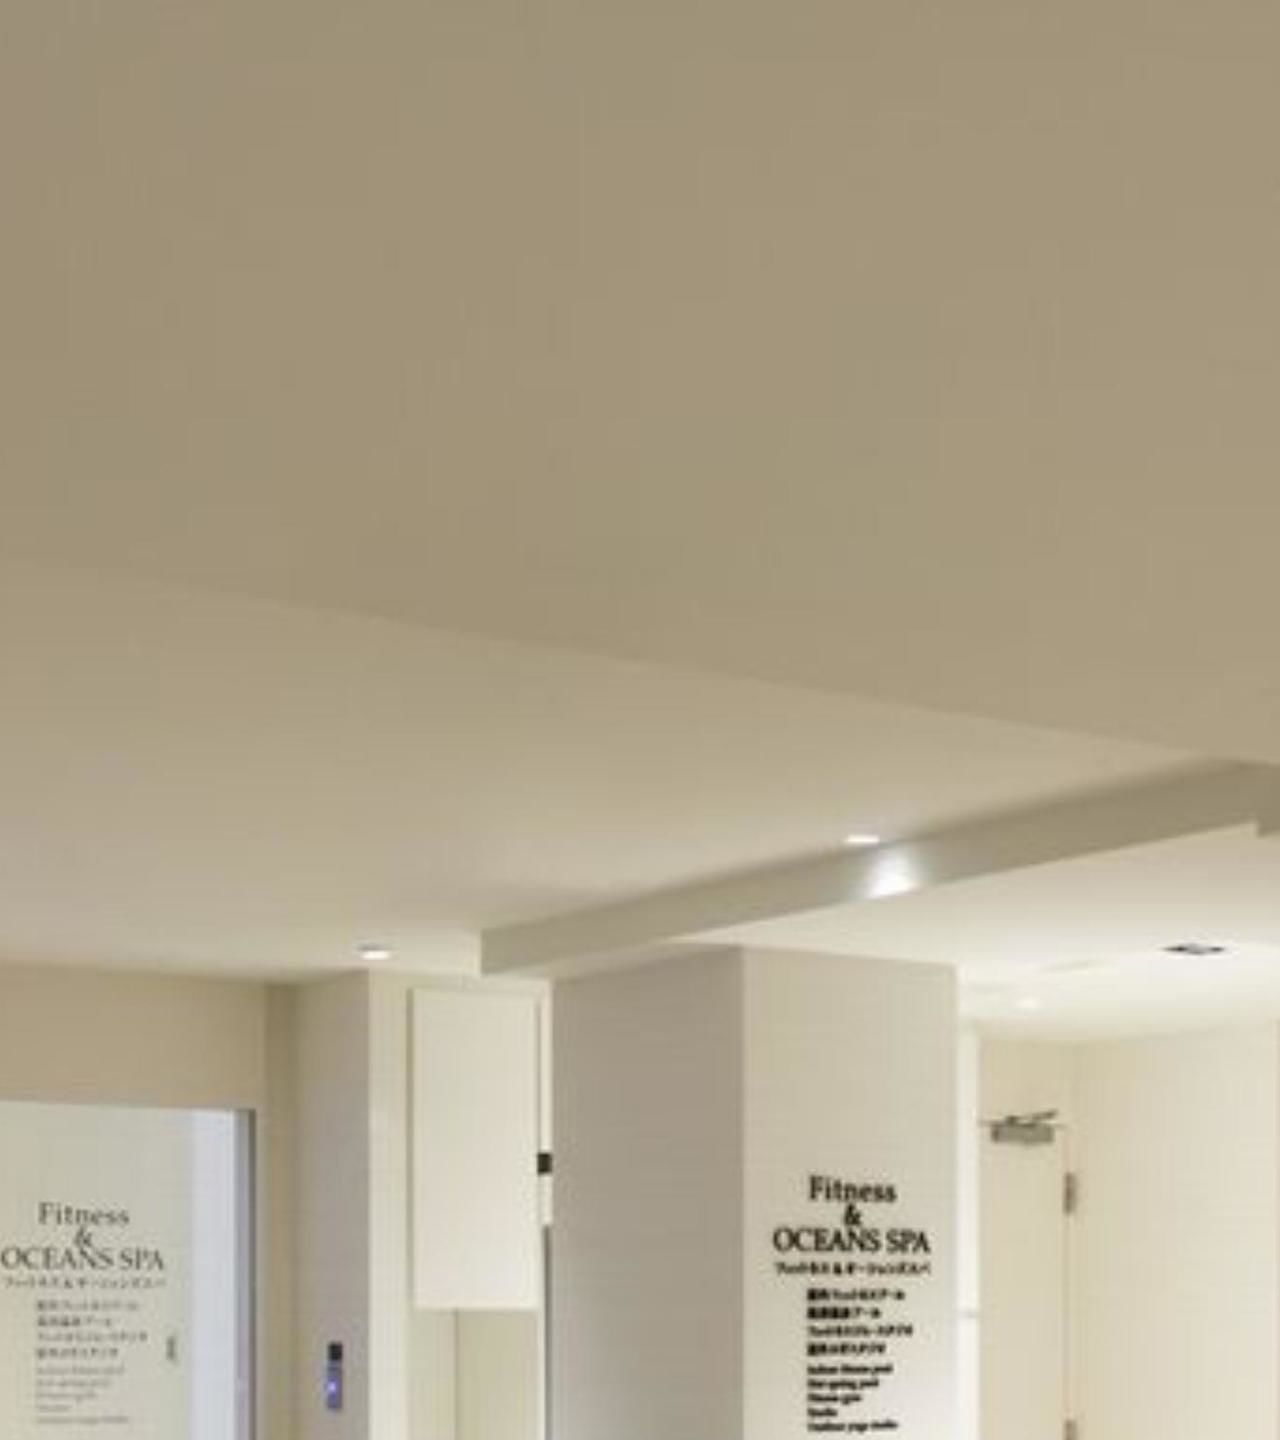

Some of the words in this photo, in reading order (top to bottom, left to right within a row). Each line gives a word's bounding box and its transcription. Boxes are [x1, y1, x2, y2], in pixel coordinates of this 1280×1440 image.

[809, 1174, 897, 1202] Fitness
[38, 1201, 130, 1226] Fitness
[844, 1202, 862, 1226] &
[773, 1226, 882, 1252] OCEANS
[886, 1229, 931, 1253] SPA
[0, 1247, 114, 1271] OCEANS
[119, 1248, 164, 1271] SPA
